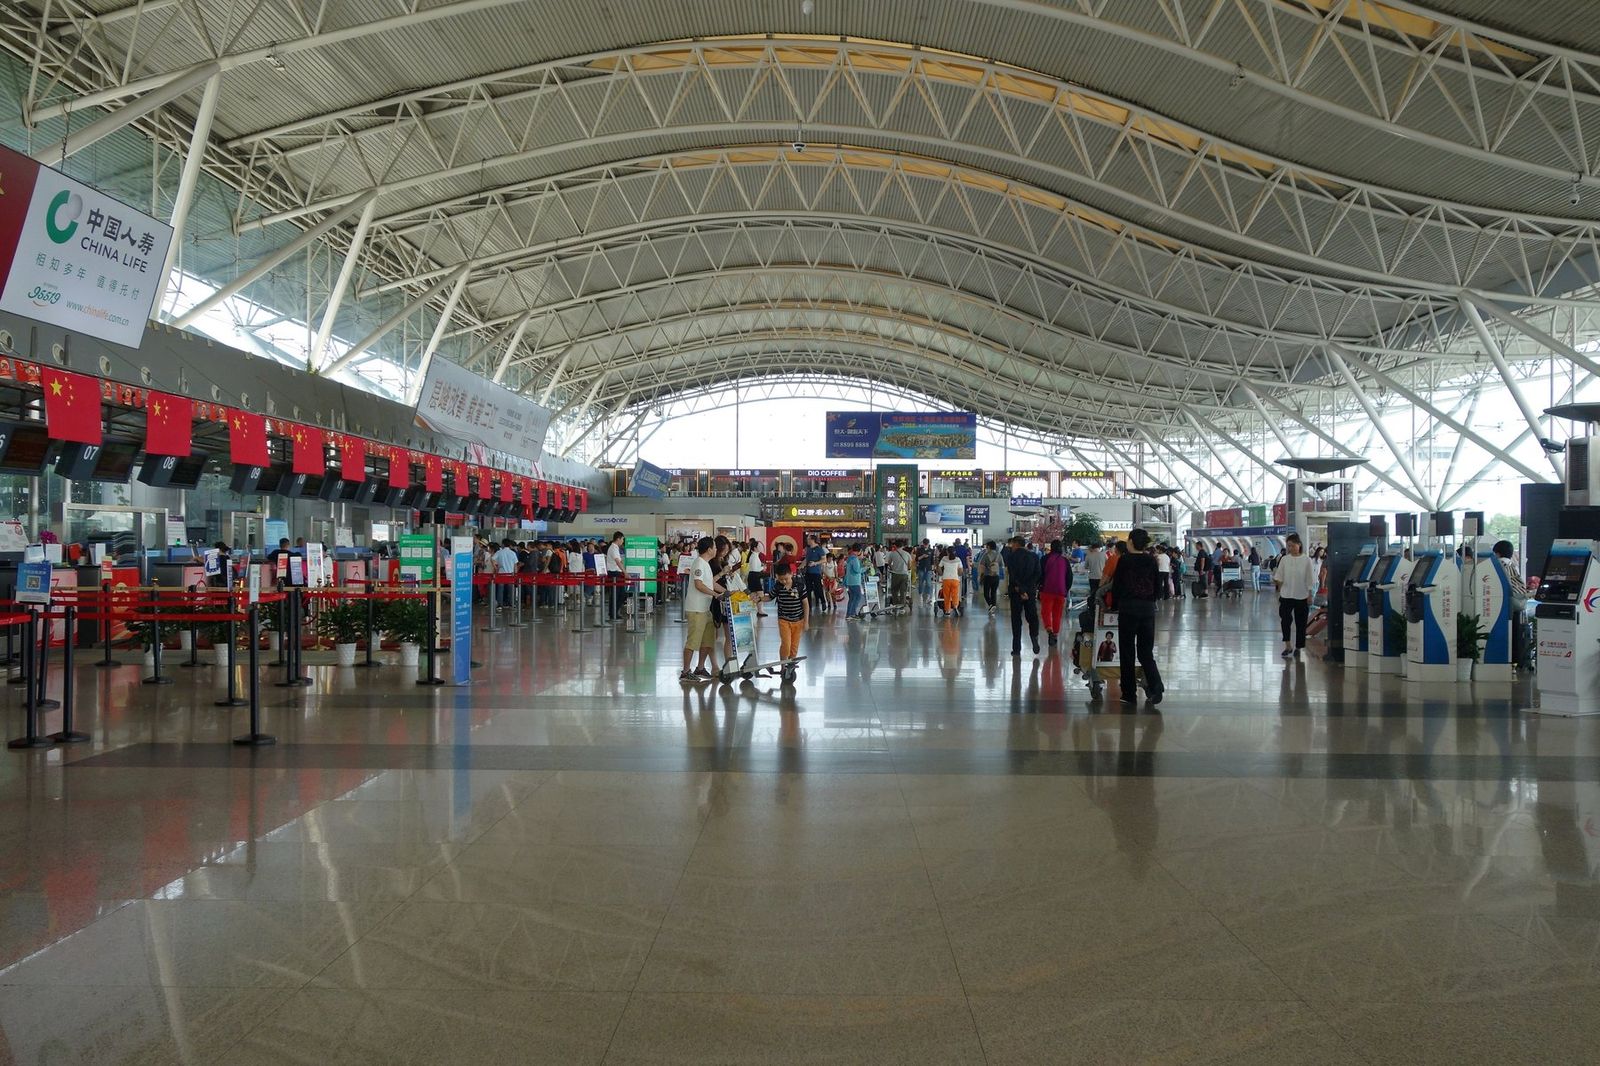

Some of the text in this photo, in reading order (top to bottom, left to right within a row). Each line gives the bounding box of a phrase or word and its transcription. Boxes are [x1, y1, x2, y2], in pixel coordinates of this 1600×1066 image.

[86, 207, 155, 256] 中国人寿
[81, 236, 148, 273] CHINA LIFE
[35, 251, 141, 300] 相知多年 值得托付
[27, 285, 62, 305] 95519
[83, 446, 99, 460] 07
[163, 456, 176, 470] 08
[250, 467, 261, 479] 09
[297, 474, 306, 485] 10
[336, 480, 344, 489] 11
[370, 484, 377, 493] 12
[899, 476, 907, 526] 兰州牛肉拉面
